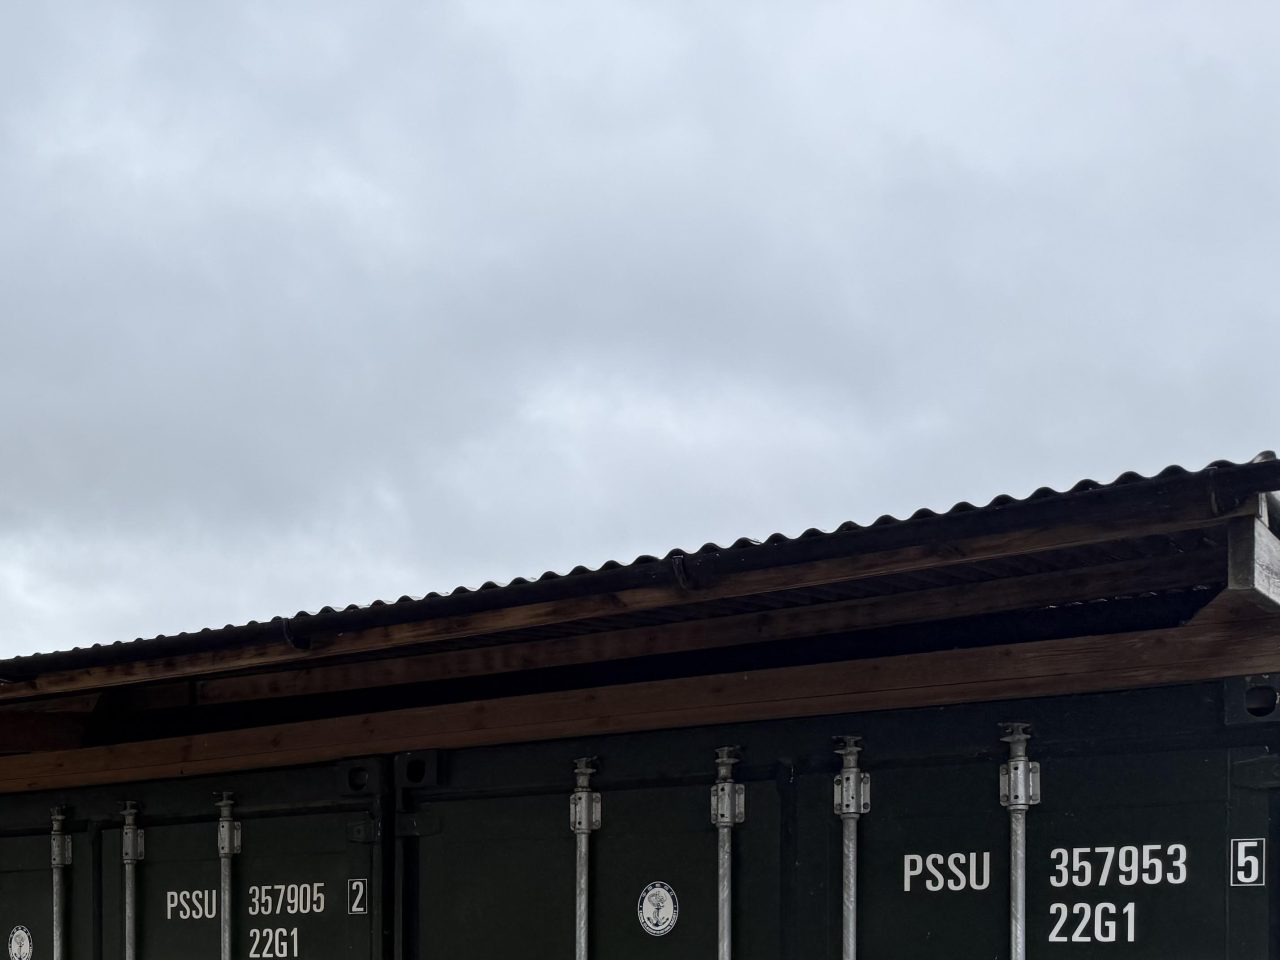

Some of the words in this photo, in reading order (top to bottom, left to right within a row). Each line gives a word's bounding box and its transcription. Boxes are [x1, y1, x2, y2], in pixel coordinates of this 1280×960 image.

[904, 852, 990, 891] PSSU
[1050, 844, 1186, 887] 357953
[1235, 840, 1259, 885] 5
[167, 890, 216, 919] PSSU
[249, 883, 324, 915] 357905
[351, 881, 364, 913] 2
[1048, 902, 1135, 942] 22G1
[249, 928, 297, 958] 22G1
